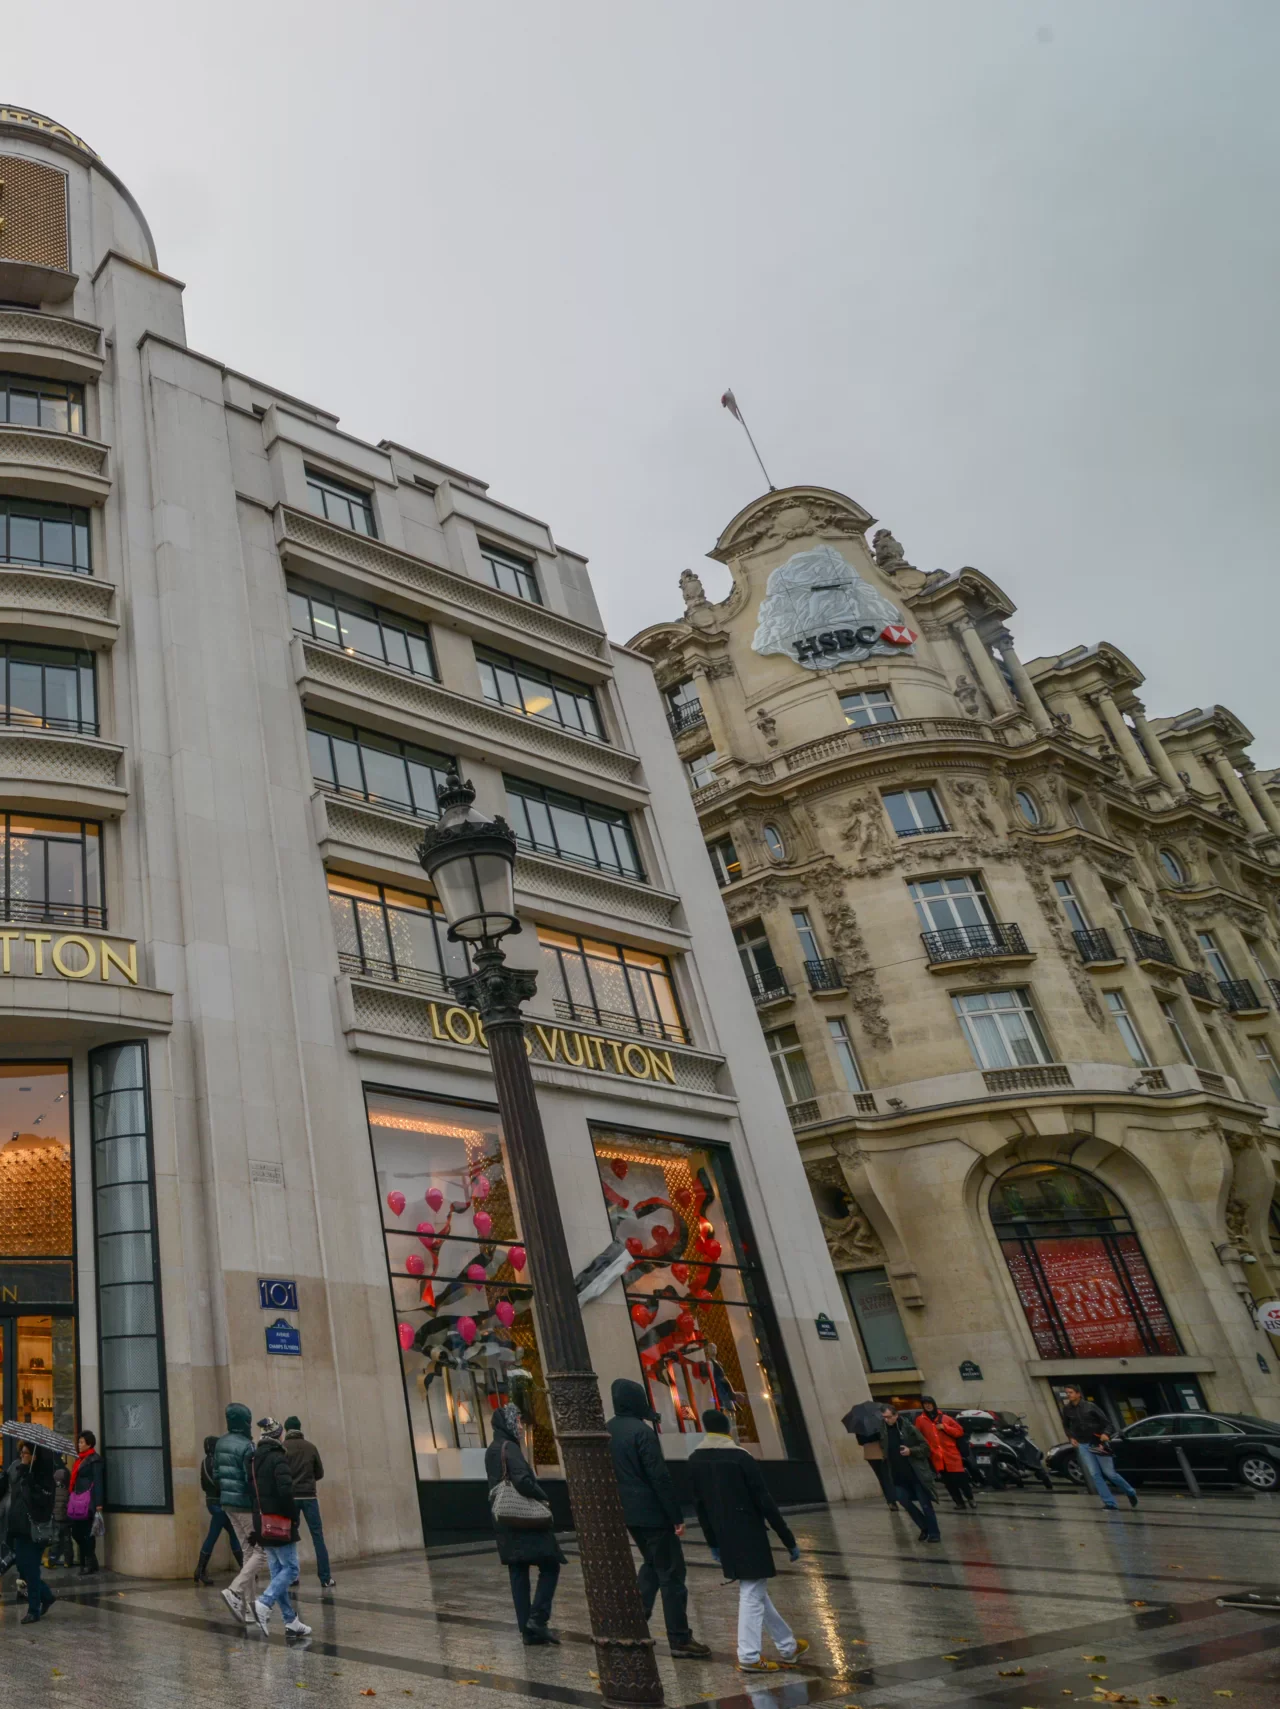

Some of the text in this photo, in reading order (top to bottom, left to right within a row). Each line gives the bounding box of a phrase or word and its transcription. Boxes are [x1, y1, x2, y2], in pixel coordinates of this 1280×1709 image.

[792, 625, 880, 663] HSBC
[536, 1024, 677, 1084] VUITTON
[261, 1282, 295, 1306] 101
